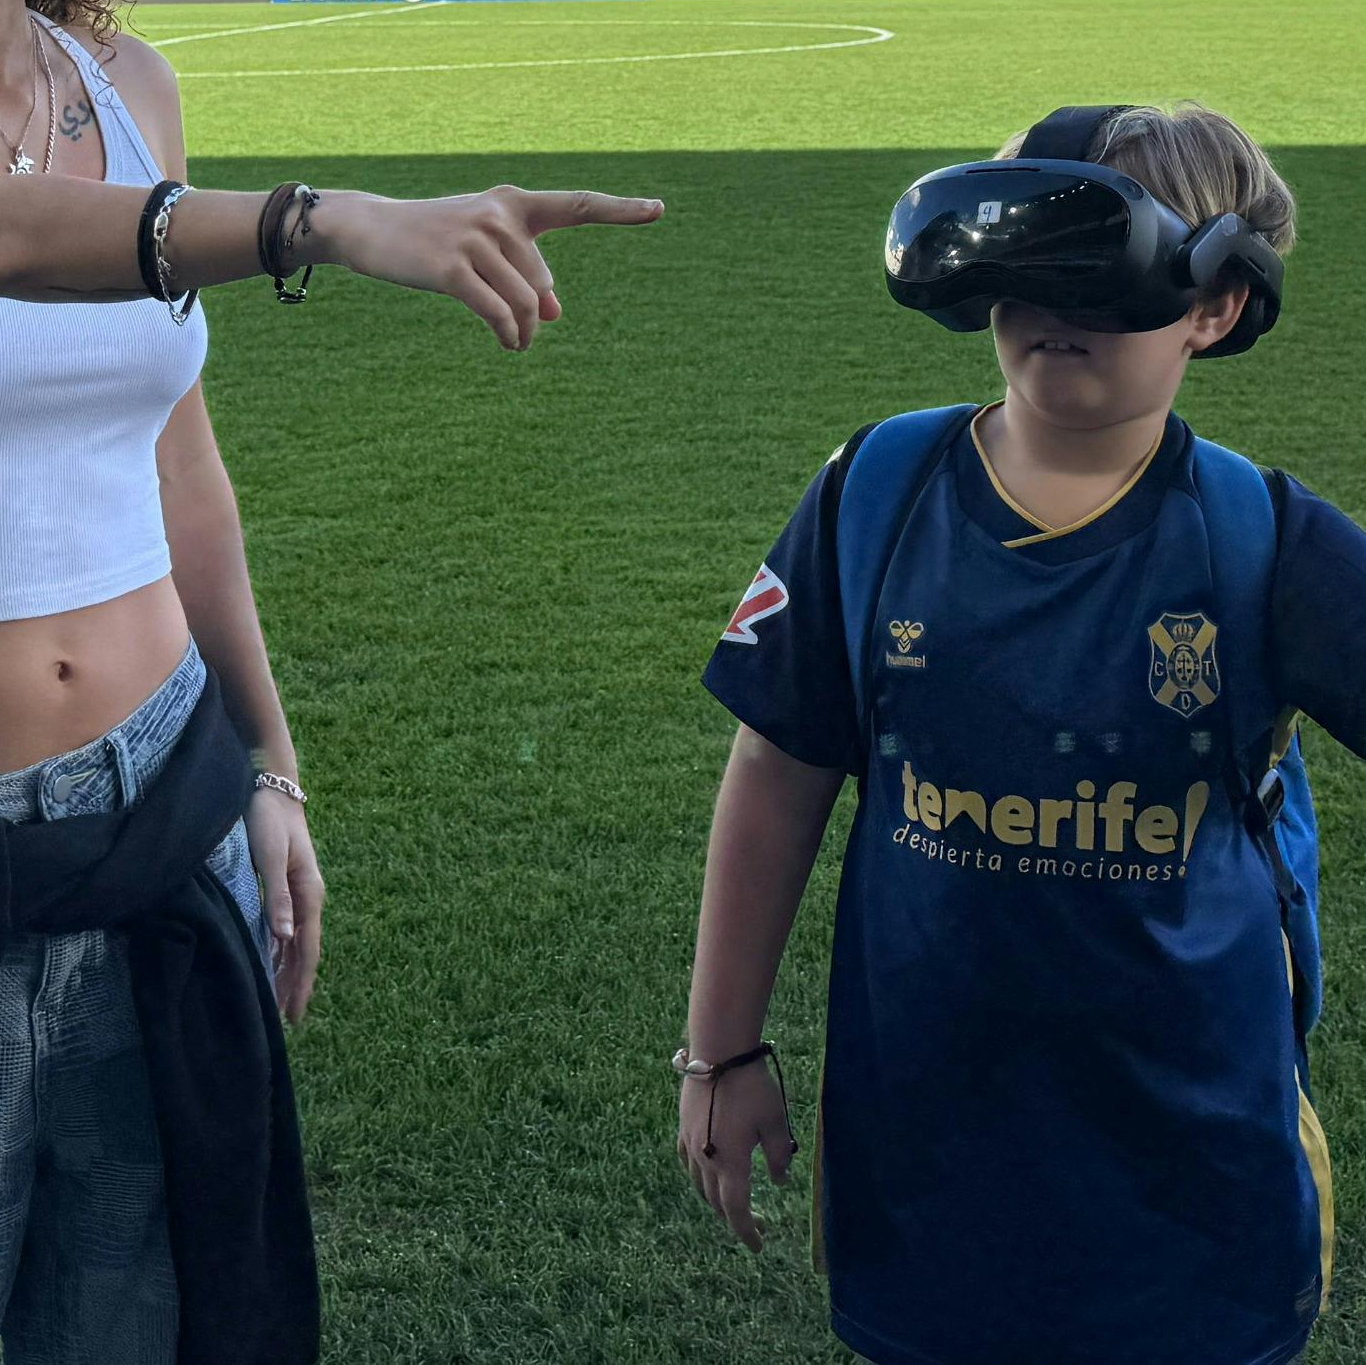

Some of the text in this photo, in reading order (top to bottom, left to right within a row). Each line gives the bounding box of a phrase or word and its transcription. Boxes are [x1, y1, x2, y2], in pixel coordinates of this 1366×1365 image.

[1203, 660, 1212, 675] T
[892, 824, 1172, 881] despierta emociones
